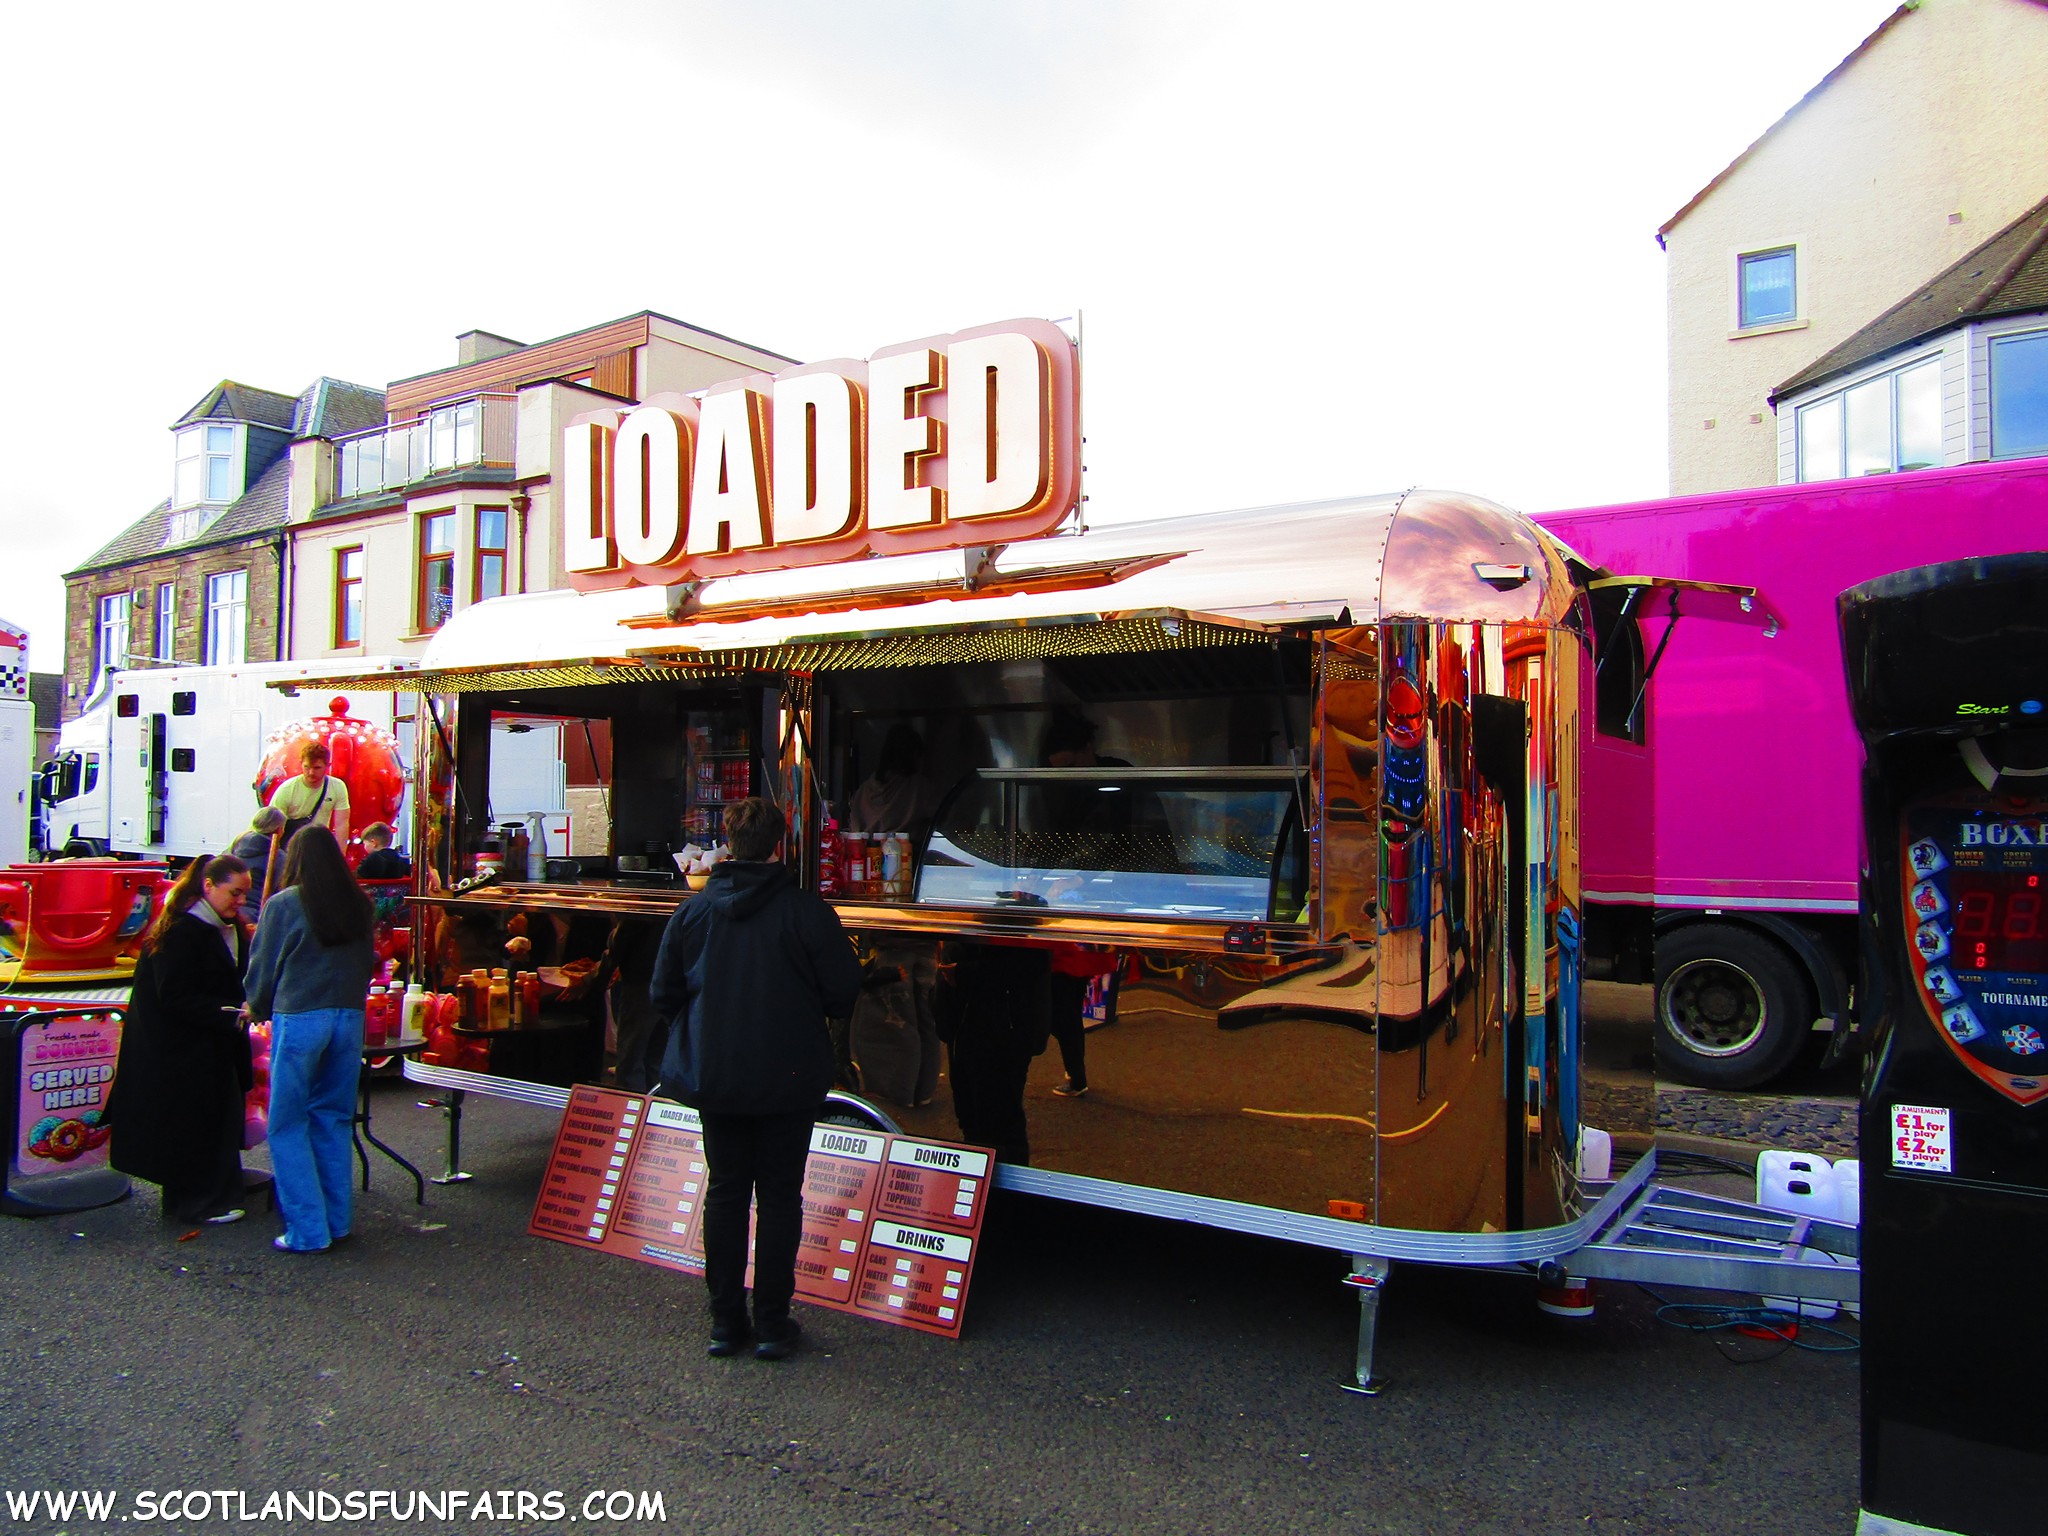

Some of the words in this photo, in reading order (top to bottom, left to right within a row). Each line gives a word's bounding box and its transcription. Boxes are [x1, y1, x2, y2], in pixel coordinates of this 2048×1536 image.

[565, 333, 1054, 575] LOADED
[1956, 704, 2009, 715] Start
[2028, 875, 2038, 887] 0
[1976, 943, 1985, 953] 0
[1976, 956, 1985, 967] 0
[2015, 1031, 2032, 1048] &
[36, 1039, 111, 1060] DONUTS
[31, 1064, 115, 1092] SERVED
[44, 1086, 101, 1111] HERE
[572, 1106, 614, 1120] CHEESEBURGER
[660, 1109, 683, 1121] LOADED
[568, 1119, 592, 1131] CHICKEN
[592, 1123, 615, 1135] BURGER
[1896, 1113, 1925, 1130] £1
[1926, 1122, 1945, 1132] for
[674, 1136, 695, 1148] BACON
[1914, 1130, 1937, 1139] play
[820, 1133, 868, 1155] LOADED
[1896, 1136, 1926, 1153] £2
[1927, 1145, 1946, 1155] for
[914, 1148, 961, 1168] DONUTS
[1912, 1153, 1940, 1162] plays
[810, 1159, 836, 1171] BURGER
[840, 1164, 867, 1178] HOTDOG
[896, 1169, 921, 1182] DONUT
[808, 1170, 837, 1183] CHICKEN
[837, 1175, 864, 1188] BURGER
[808, 1181, 837, 1195] CHICKEN
[837, 1187, 858, 1199] WRAP
[894, 1181, 924, 1195] DONUTS
[886, 1192, 922, 1208] TOPPINGS
[802, 1200, 816, 1212] EESE
[823, 1204, 847, 1218] BACON
[809, 1233, 829, 1246] PORK
[896, 1229, 945, 1252] DRINKS
[803, 1261, 828, 1275] CURRY
[869, 1253, 887, 1265] CANS
[913, 1262, 925, 1275] TEA
[866, 1269, 888, 1282] WATER
[909, 1279, 933, 1293] COFFEE
